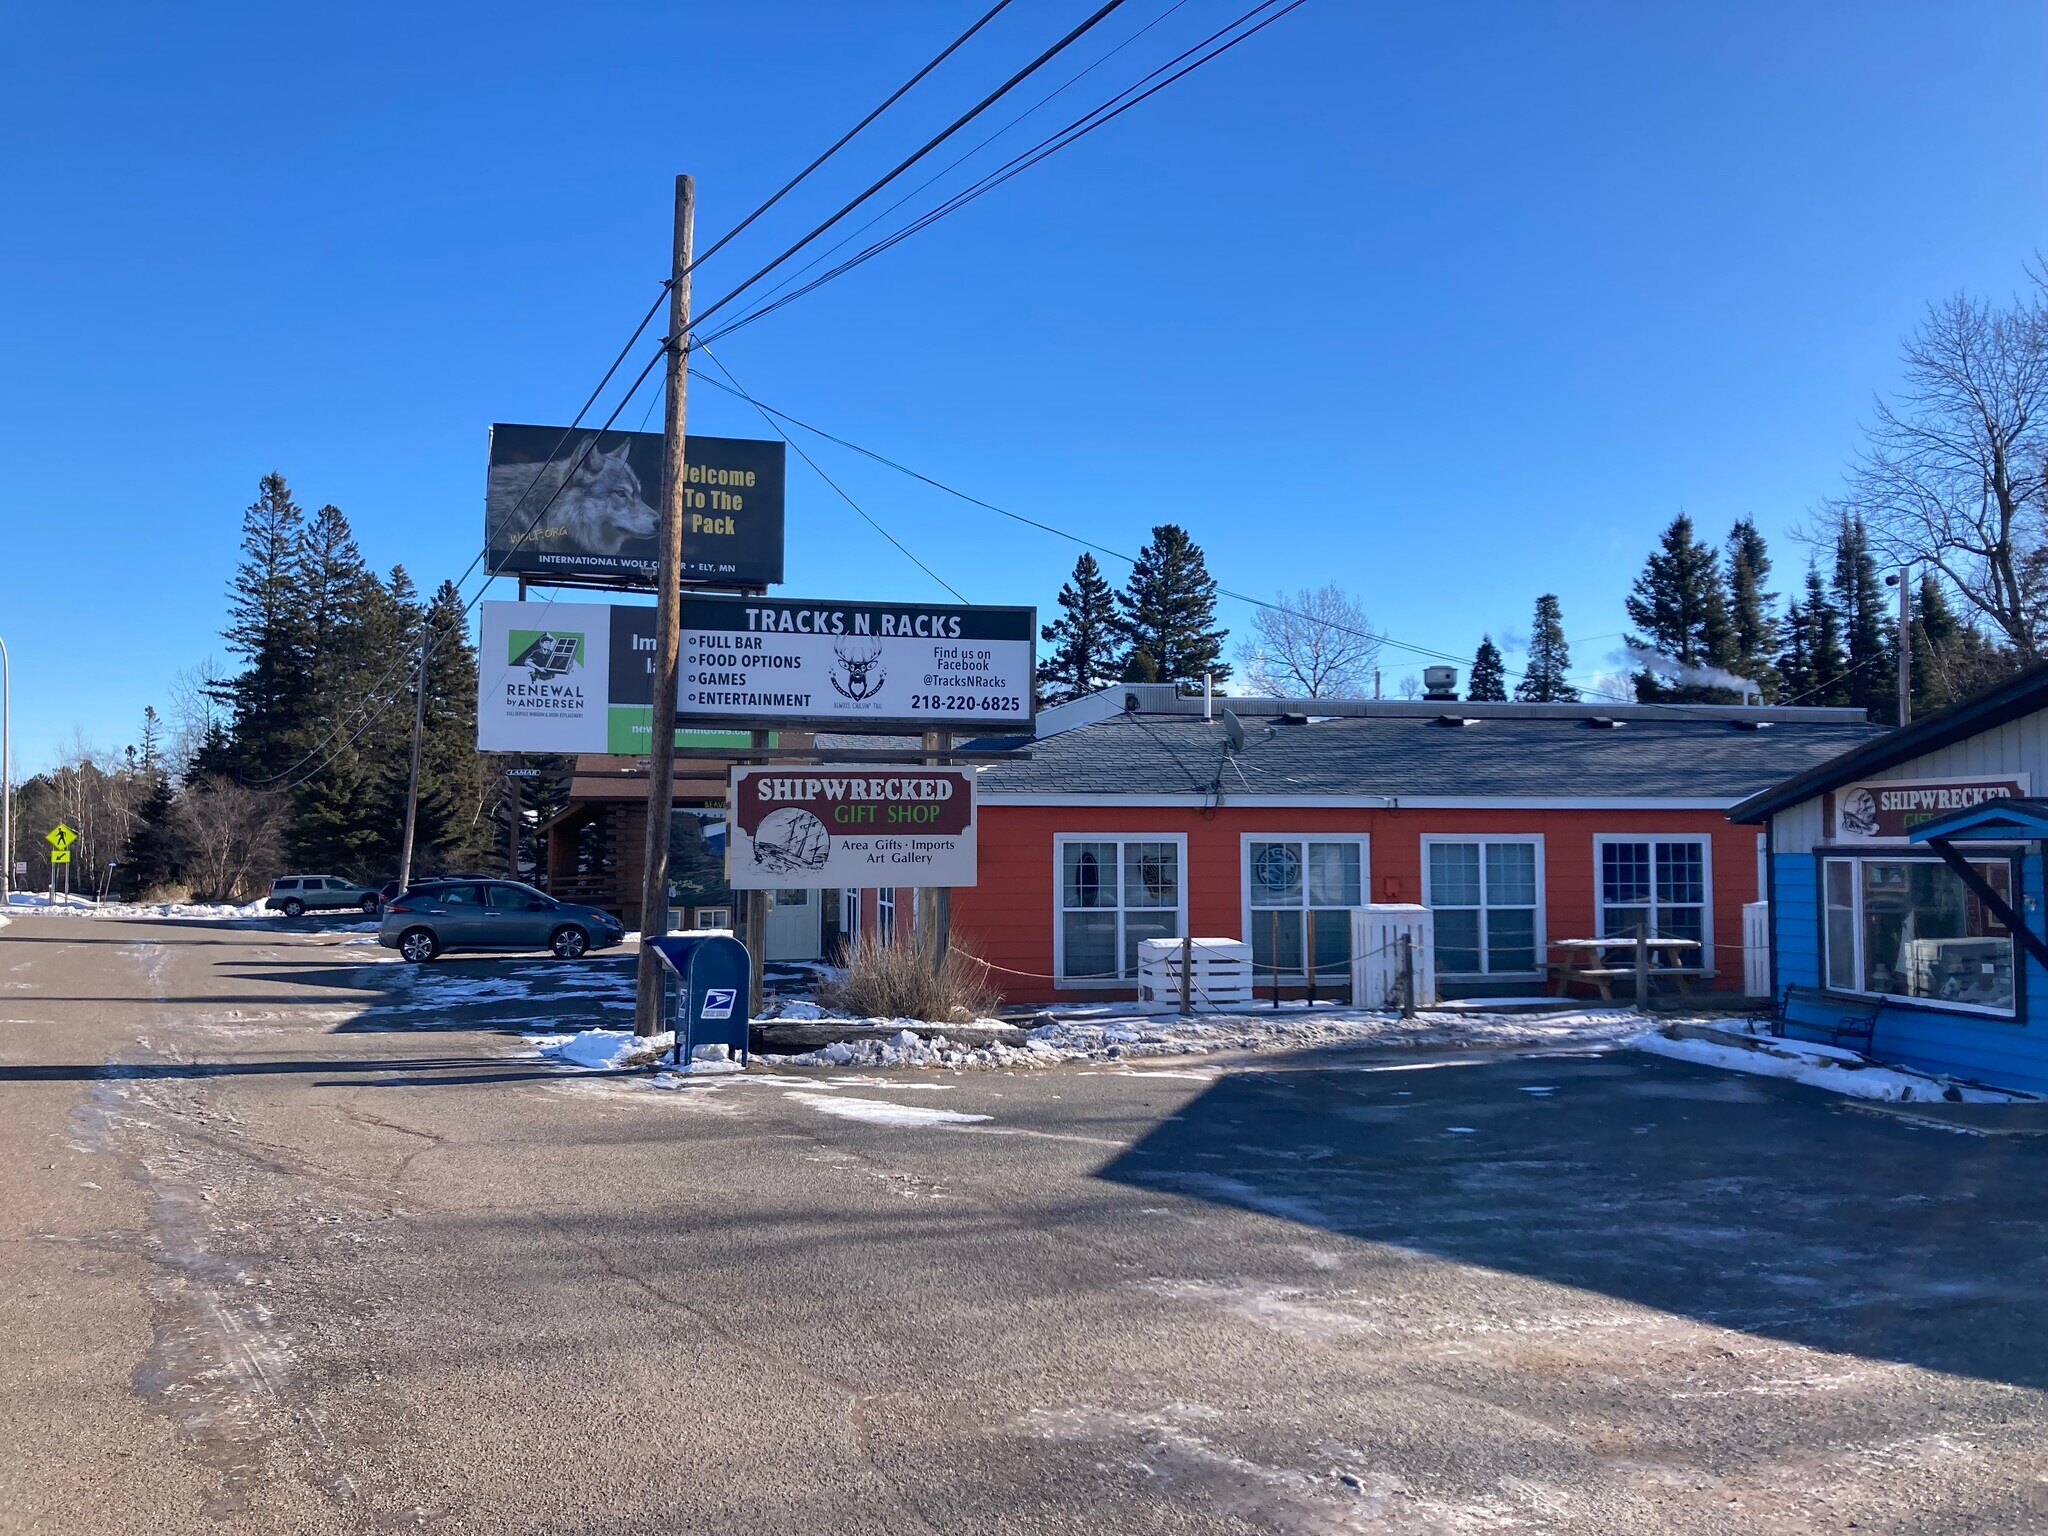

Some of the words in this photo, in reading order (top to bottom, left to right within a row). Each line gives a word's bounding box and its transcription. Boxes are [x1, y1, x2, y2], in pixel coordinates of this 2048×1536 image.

[684, 489, 706, 509] To
[710, 490, 743, 511] The
[692, 514, 736, 535] Pack
[510, 526, 568, 544] WOLF.ORG
[538, 555, 618, 567] INTERNATIONAL
[620, 558, 649, 568] WOLF
[698, 563, 717, 573] ELY,
[719, 564, 736, 573] MN
[745, 608, 845, 635] TRACKS
[854, 613, 870, 635] N
[881, 614, 961, 638] RACKS
[699, 635, 731, 649] FULL
[735, 636, 763, 650] BAR
[933, 646, 958, 659] Find
[961, 650, 974, 659] us
[977, 650, 991, 660] on
[699, 653, 737, 667] FOOD
[741, 655, 802, 669] OPTIONS
[937, 658, 990, 671] Facebook
[698, 672, 747, 686] GAMES
[923, 673, 1006, 688] @TracksNRacks
[507, 683, 584, 698] RENEWAL
[506, 697, 517, 707] by
[518, 698, 584, 709] ANDERSEN
[698, 691, 811, 707] ENTERTAINMENT
[911, 694, 1020, 711] 218-220-6825
[757, 777, 953, 801] SHIPWRECKED
[704, 800, 728, 808] BEAVE
[834, 804, 878, 824] GIFT
[887, 804, 941, 823] SHOP
[841, 840, 869, 850] Area
[875, 839, 902, 850] Gifts
[911, 839, 955, 852] Imports
[866, 853, 885, 863] Art
[891, 852, 933, 865] Gallery
